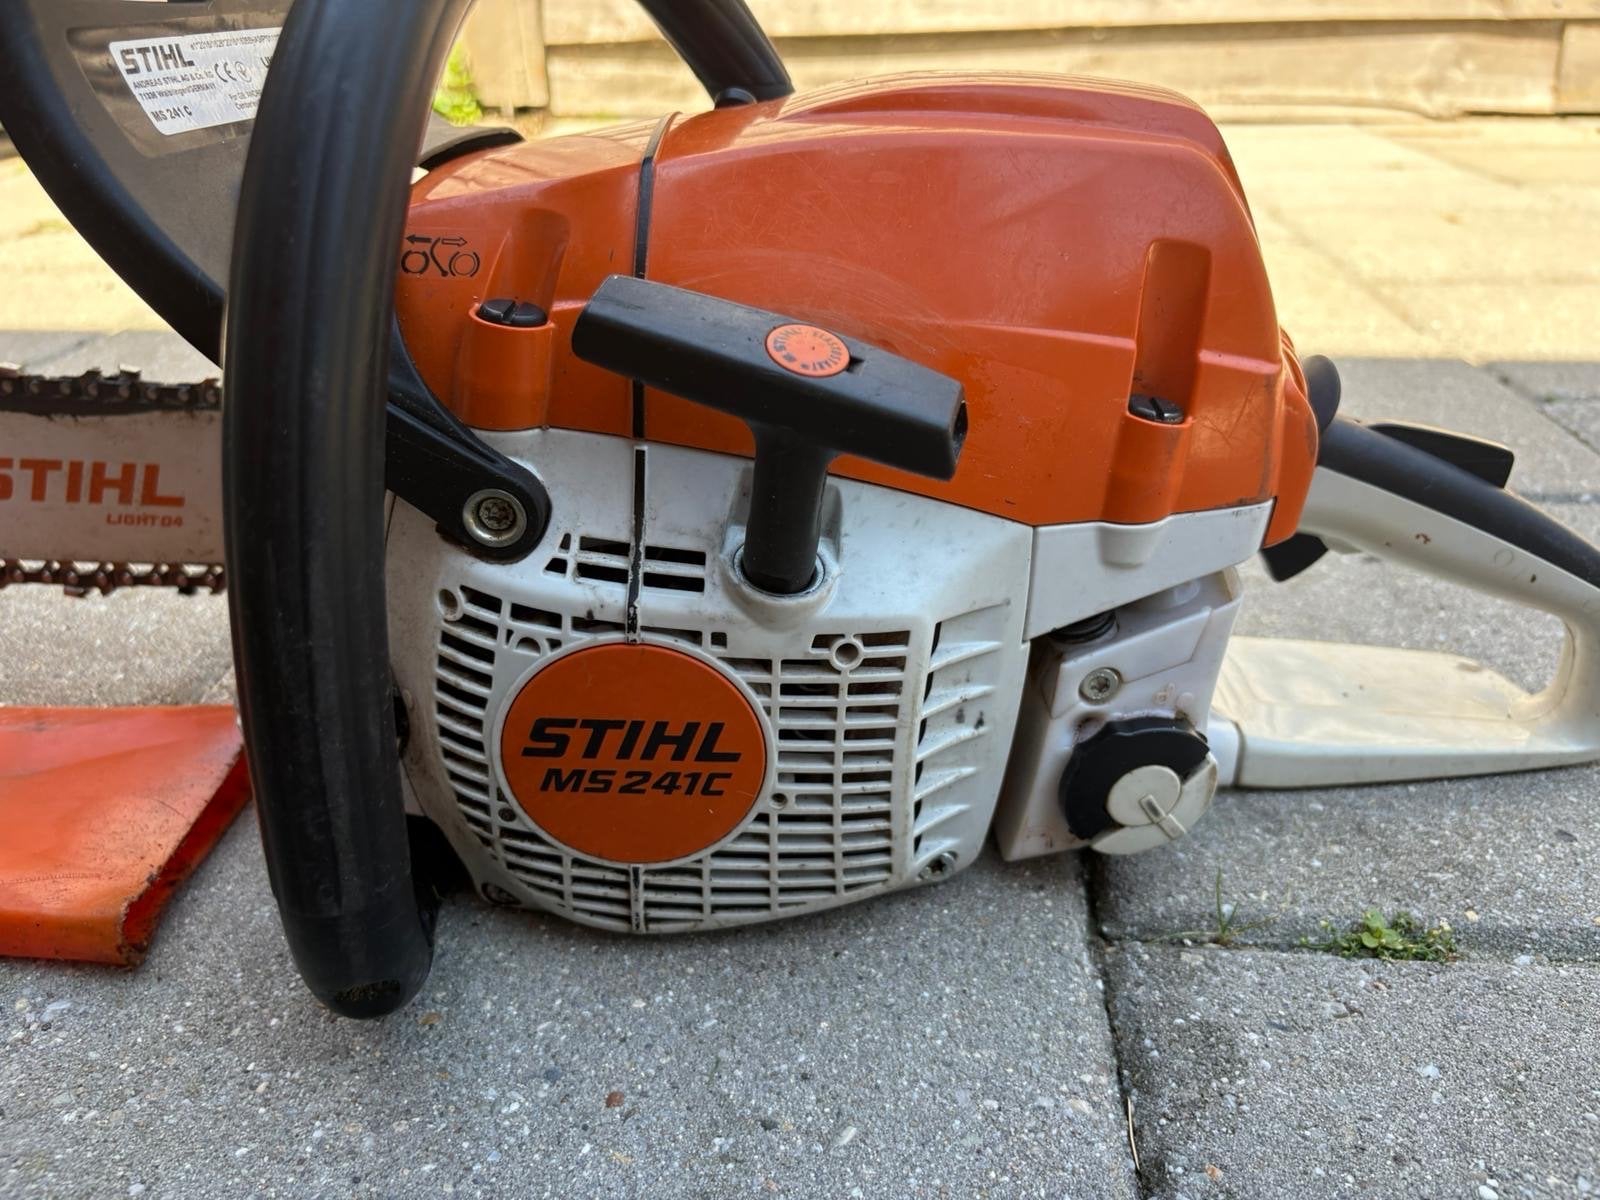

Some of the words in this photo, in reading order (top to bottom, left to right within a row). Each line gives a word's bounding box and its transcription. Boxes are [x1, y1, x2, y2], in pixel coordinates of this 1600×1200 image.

[120, 43, 195, 75] STIHL
[133, 77, 163, 89] ANDREAS
[162, 75, 181, 84] STIHL
[151, 108, 168, 122] MS
[166, 106, 185, 119] 241
[184, 104, 192, 117] C
[521, 717, 742, 762] STIHL
